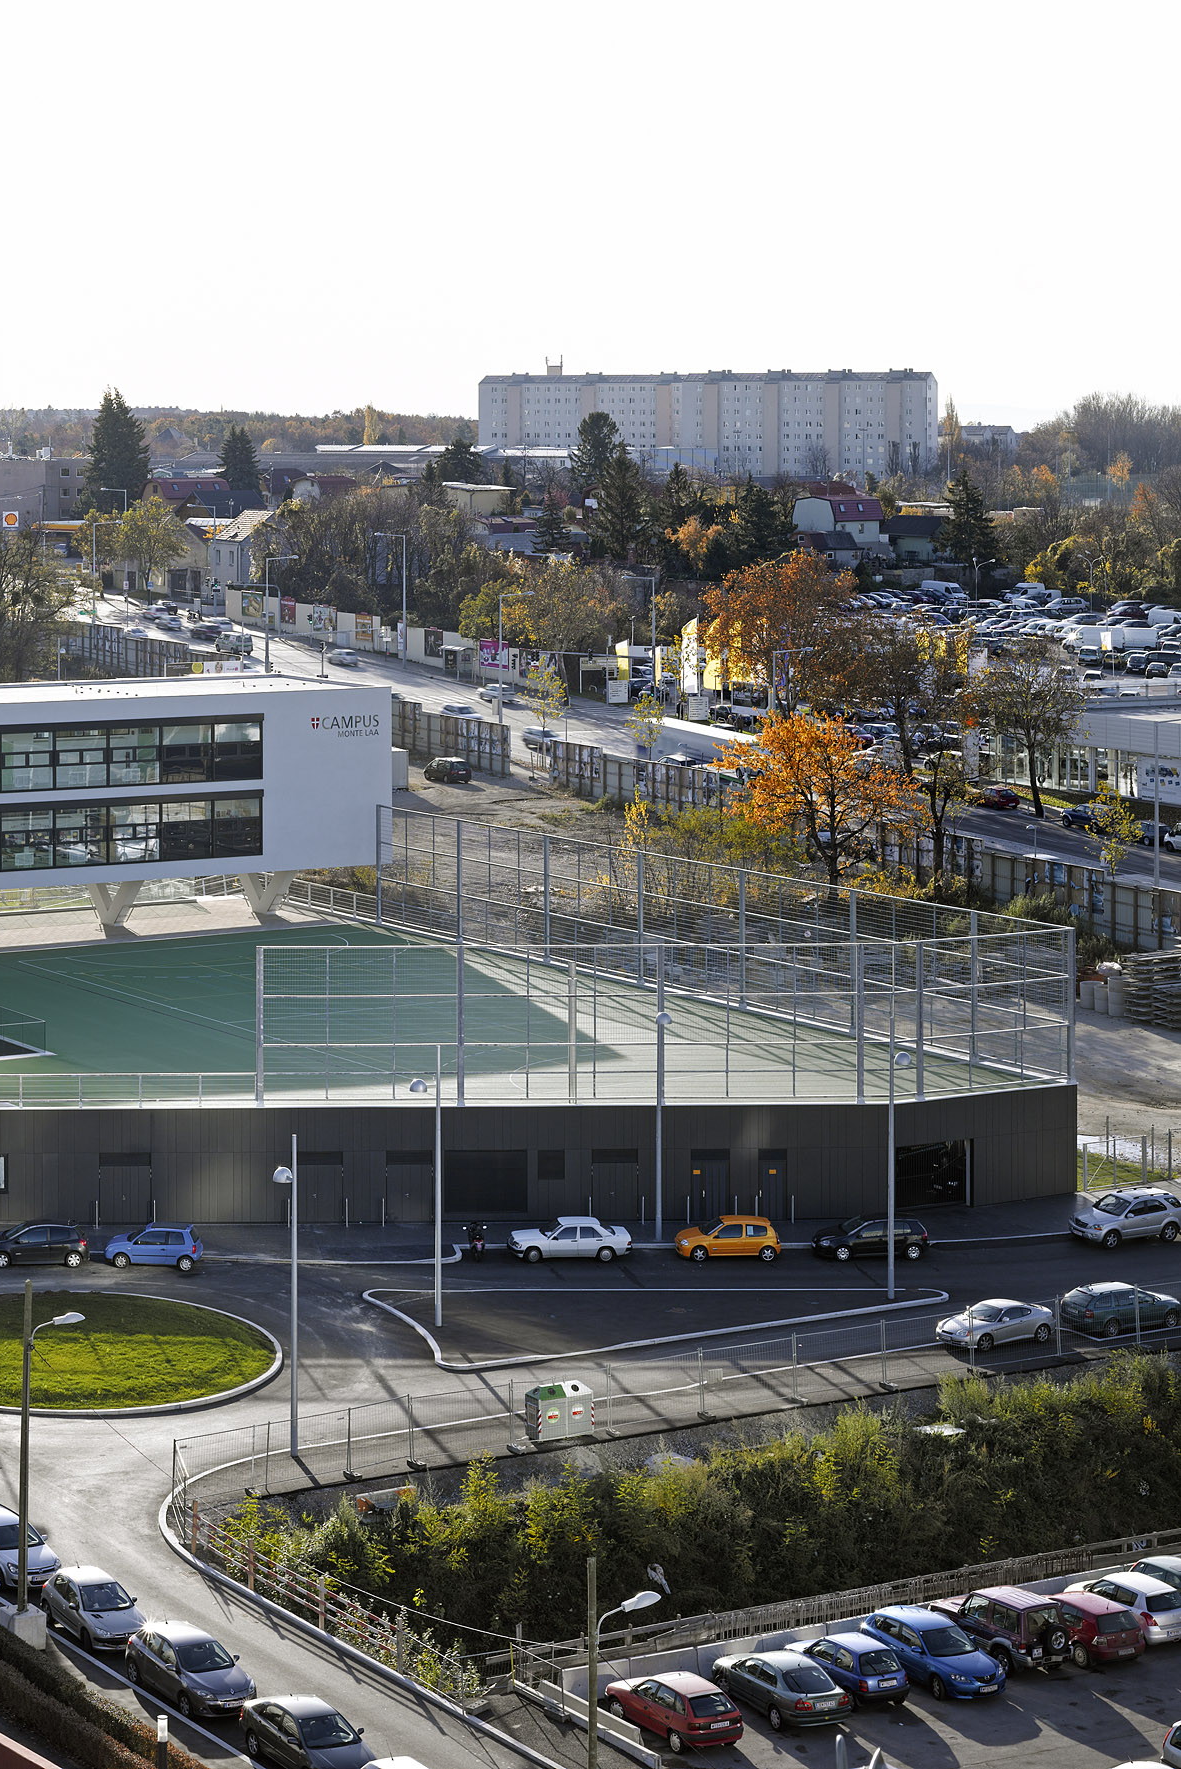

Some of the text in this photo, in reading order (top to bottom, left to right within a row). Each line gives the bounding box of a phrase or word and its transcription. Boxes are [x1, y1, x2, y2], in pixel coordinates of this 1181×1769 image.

[321, 714, 380, 730] CAMPUS
[337, 728, 380, 738] MONTE LAA
